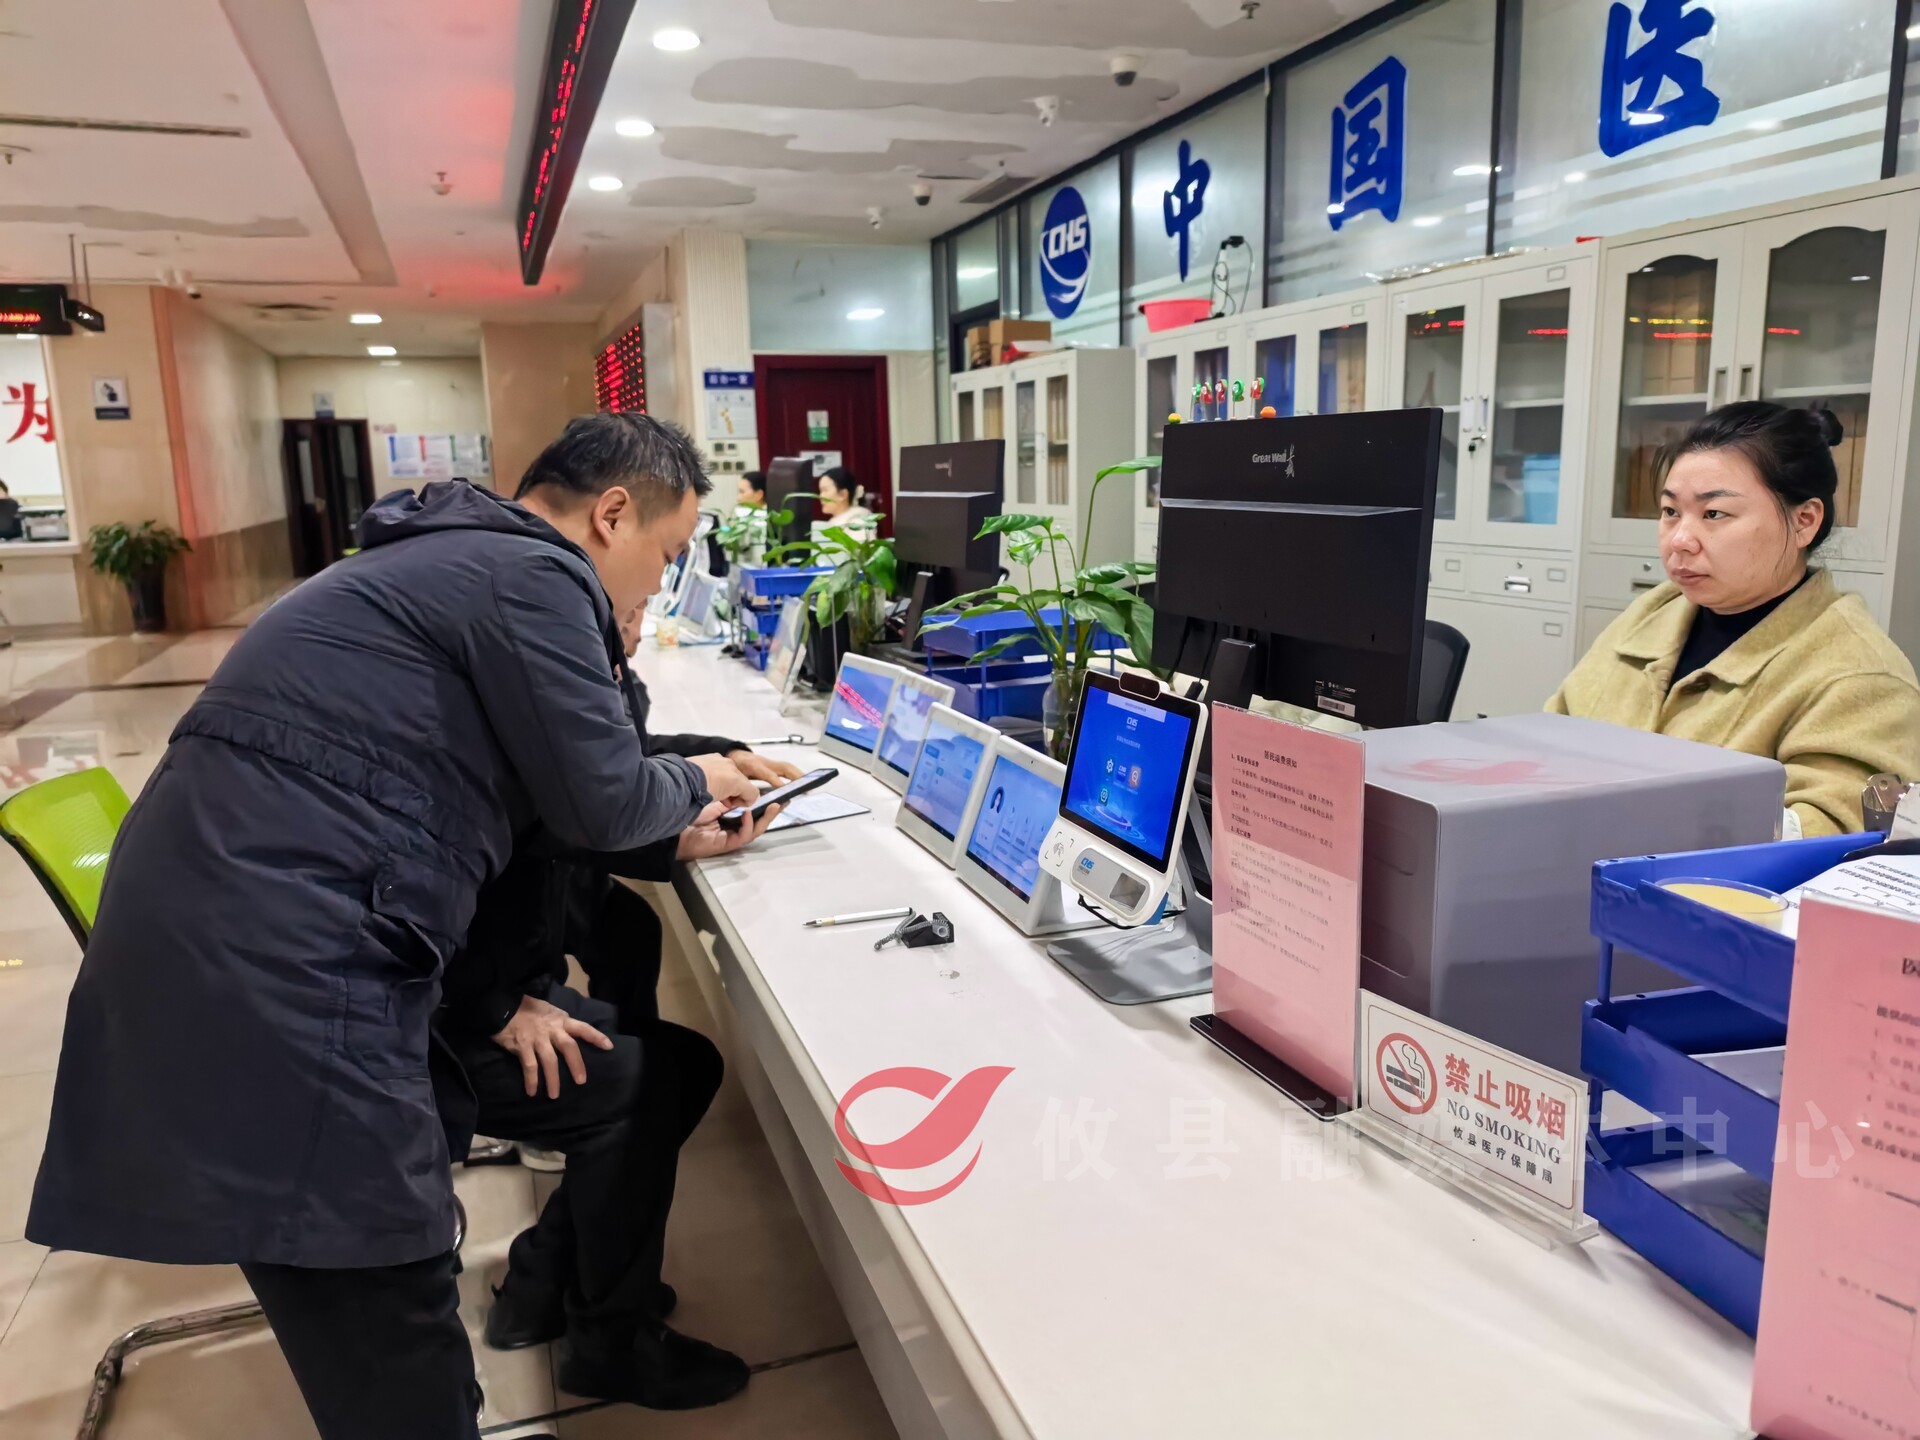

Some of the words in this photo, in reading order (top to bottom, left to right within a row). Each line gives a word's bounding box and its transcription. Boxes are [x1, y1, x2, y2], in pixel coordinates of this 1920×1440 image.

[2, 382, 56, 443] 为
[1252, 453, 1271, 463] Great
[1272, 451, 1287, 463] Wall
[1444, 1052, 1568, 1141] 禁止吸烟
[1446, 1098, 1470, 1122] NO
[1474, 1111, 1562, 1165] SMOKING
[1453, 1125, 1553, 1185] 攸县医疗保障局
